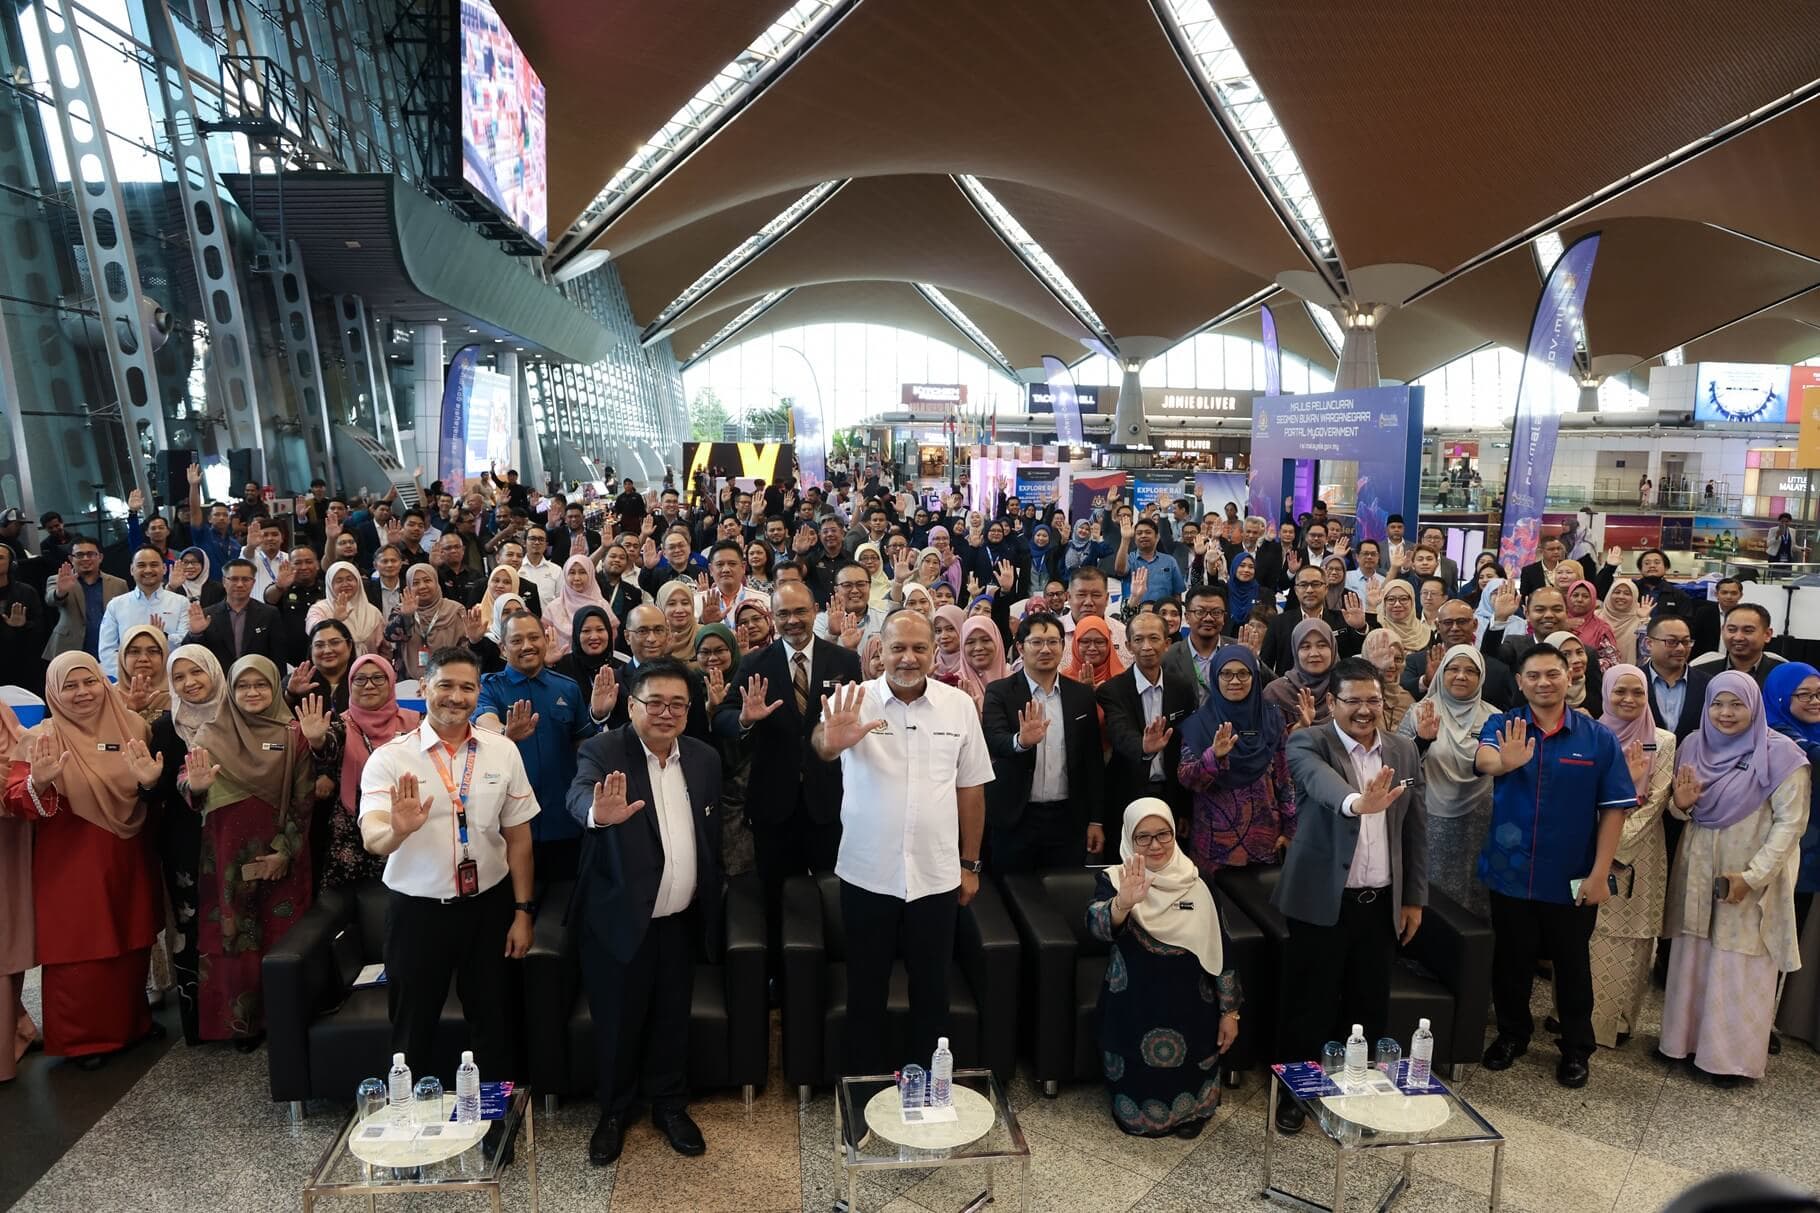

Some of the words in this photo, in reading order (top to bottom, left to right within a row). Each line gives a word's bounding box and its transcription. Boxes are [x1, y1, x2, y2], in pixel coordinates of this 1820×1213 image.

[1162, 395, 1196, 409] JAMIE
[1196, 396, 1236, 410] OLIVER
[1276, 414, 1299, 424] SEGMEN
[1299, 413, 1320, 423] BUKAN
[1320, 411, 1371, 422] WARGANEGARA
[1284, 427, 1306, 437] PORTAL
[1779, 483, 1815, 492] MALAYSA
